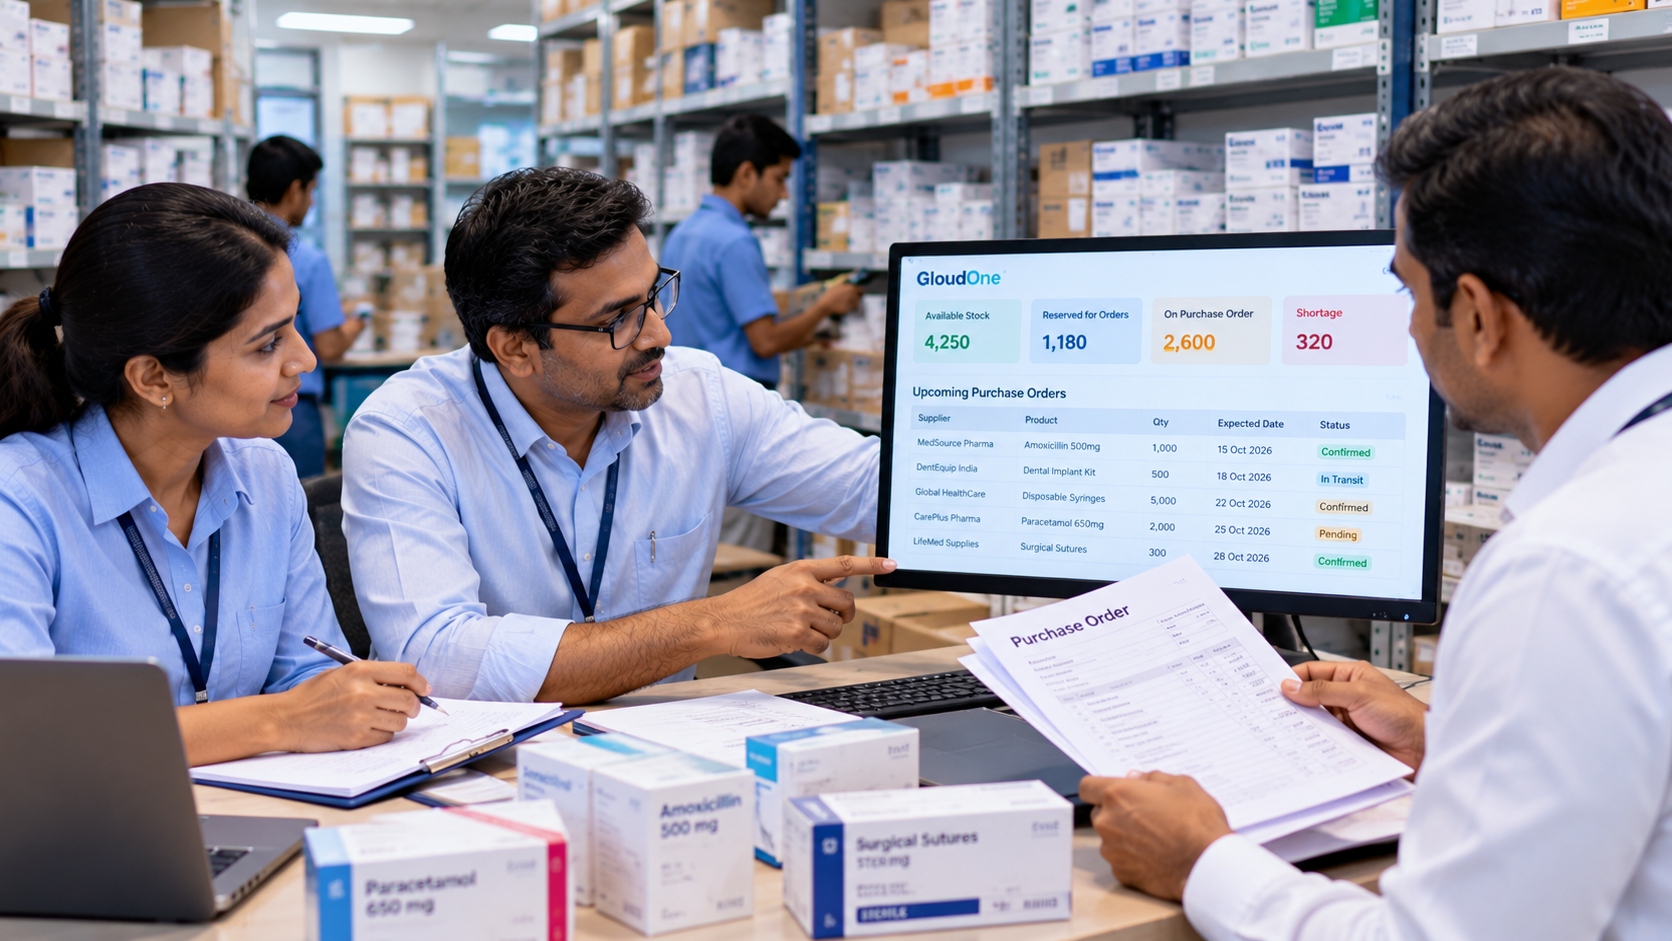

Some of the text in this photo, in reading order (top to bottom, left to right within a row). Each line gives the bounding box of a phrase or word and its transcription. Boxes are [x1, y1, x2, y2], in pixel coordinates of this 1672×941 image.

[917, 270, 1001, 286] GloudOne
[925, 311, 990, 320] Available Stock
[1043, 310, 1129, 320] Reserved for Orders
[1164, 309, 1254, 319] On Purchase Order
[1296, 308, 1343, 319] Shortage
[925, 334, 970, 352] 4,250
[1042, 334, 1087, 352] 1,180
[1163, 334, 1215, 353] 2,600
[1296, 333, 1332, 350] 320
[913, 387, 1066, 400] Upcoming Purchase Orders
[918, 414, 951, 423] Supplier
[1025, 416, 1057, 425] Product
[1153, 418, 1169, 427] Qty
[1218, 419, 1284, 429] Expected Date
[1320, 421, 1350, 429] Status
[918, 439, 994, 448] MedSource Pharma
[1024, 441, 1100, 452] Amoxicillin 500mg
[1152, 444, 1177, 453] 1,000
[1217, 445, 1272, 455] 15 Oct 2026
[1321, 448, 1371, 457] Confirmed
[917, 463, 978, 473] DentEquip India
[1024, 467, 1049, 475] Dental
[1051, 468, 1082, 478] Implant
[1152, 470, 1169, 479] 500
[1217, 472, 1272, 482] 18 Oct 2026
[1321, 475, 1364, 484] In Transit
[915, 488, 986, 498] Global HealthCare
[1023, 492, 1105, 504] Disposable Syringes
[1151, 496, 1176, 506] 5,000
[1215, 499, 1271, 508] 22 Oct 2026
[1320, 503, 1369, 512] Confirmed
[914, 513, 981, 523] CarePlus Pharma
[1022, 517, 1104, 530] Paracetamol 650mg
[1150, 523, 1175, 532] 2,000
[1215, 525, 1270, 535] 25 Oct 2026
[1319, 530, 1357, 541] Pending
[913, 538, 979, 548] LifeMed Supplies
[1021, 543, 1087, 553] Surgical Sutures
[1149, 549, 1166, 557] 300
[1214, 552, 1269, 563] 28 Oct 2026
[1318, 557, 1367, 567] Confirmed
[1010, 622, 1084, 648] Purchase
[1084, 605, 1130, 627] Order
[660, 794, 742, 818] Amoxicillin
[660, 820, 718, 839] 500 mg
[857, 832, 978, 852] Surgical Sutures
[366, 871, 476, 896] Paracetamol
[366, 900, 434, 917] 650 mg
